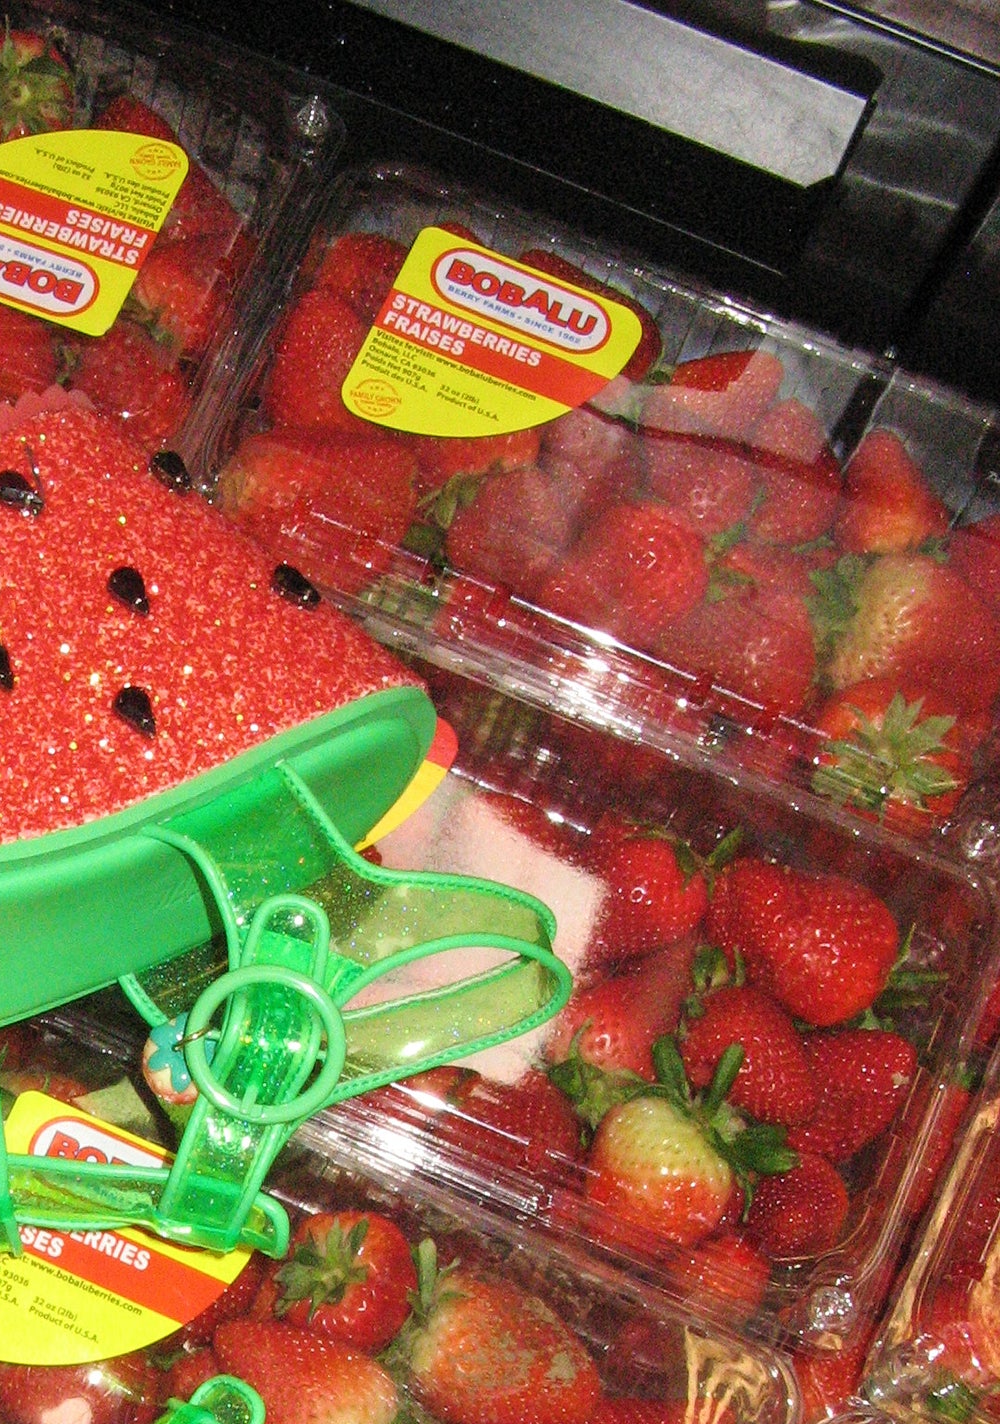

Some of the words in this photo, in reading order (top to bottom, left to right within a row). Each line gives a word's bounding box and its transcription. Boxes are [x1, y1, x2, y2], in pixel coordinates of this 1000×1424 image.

[65, 209, 148, 249] FRAISES
[445, 258, 598, 336] BOBALU
[447, 284, 480, 302] BERRY
[482, 299, 515, 318] FARMS
[524, 317, 554, 333] SINCE
[383, 310, 465, 355] FRAISES
[392, 294, 541, 366] STRAWBERRIES
[3, 1269, 29, 1286] 93036
[30, 1259, 142, 1315] www.bobaluberries.com
[28, 1305, 63, 1326] Product
[63, 1322, 74, 1331] of
[74, 1326, 98, 1343] U.S.A.
